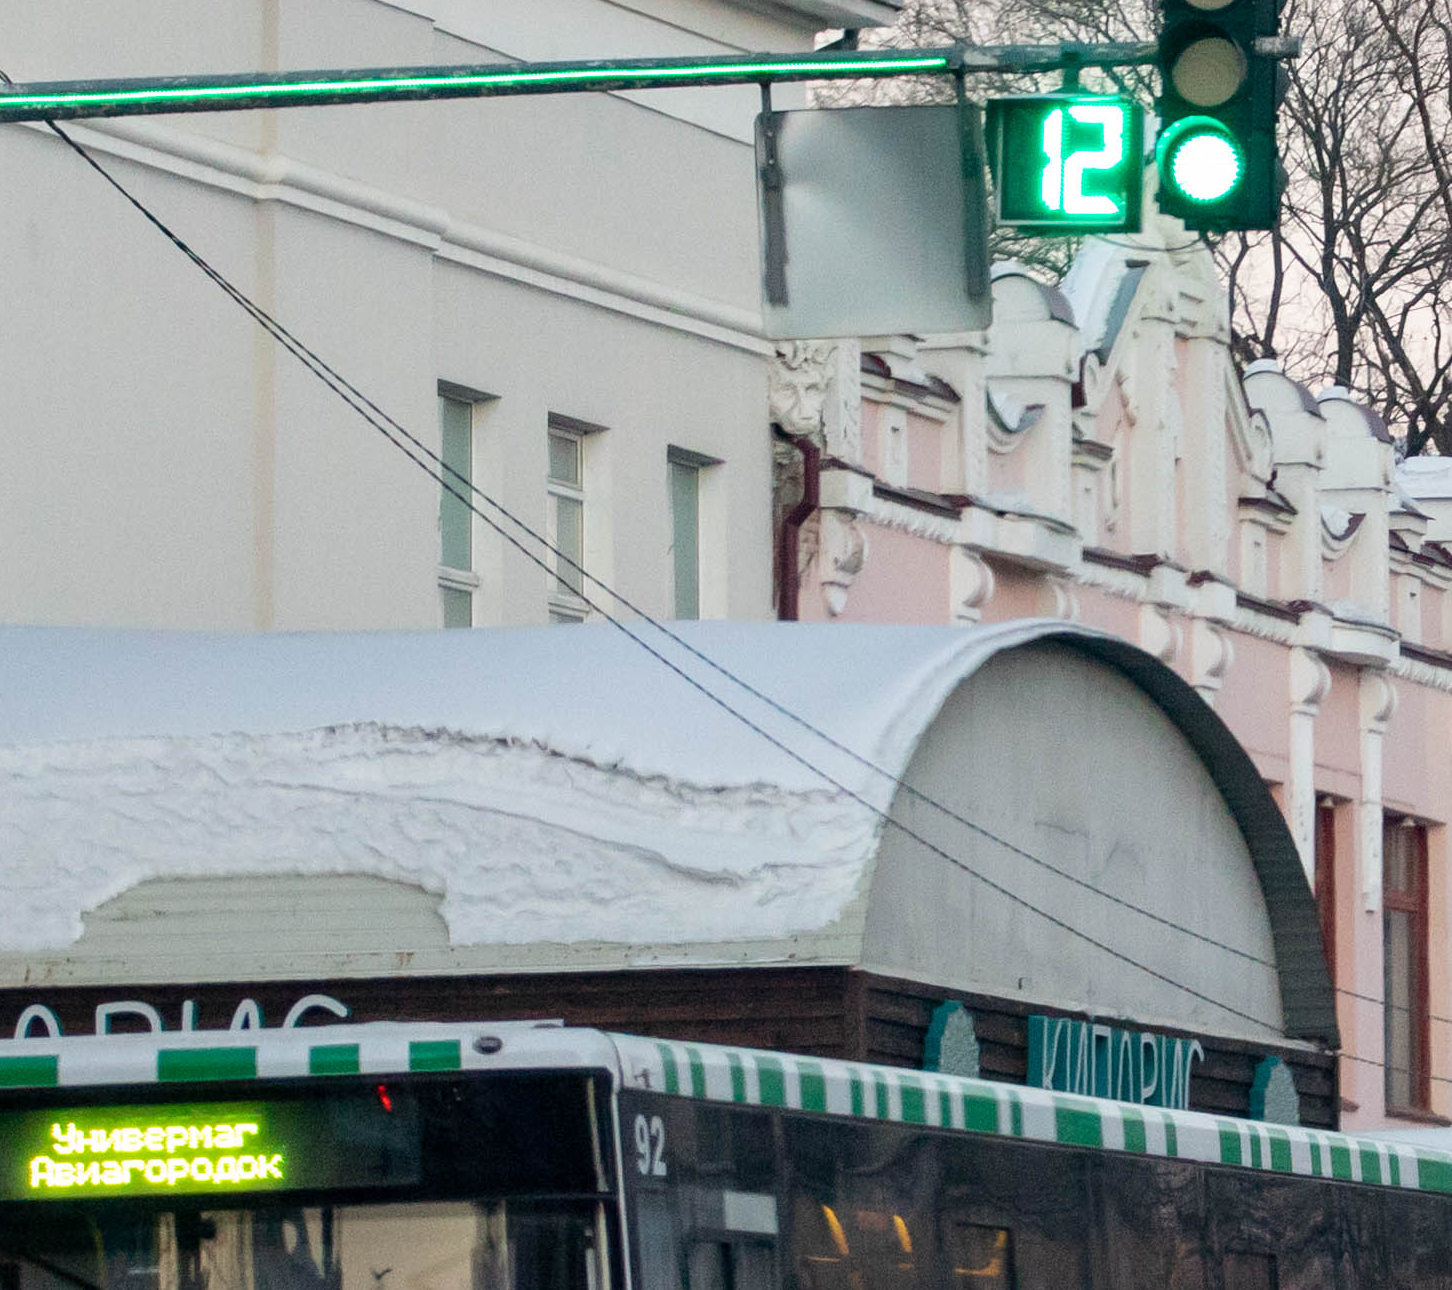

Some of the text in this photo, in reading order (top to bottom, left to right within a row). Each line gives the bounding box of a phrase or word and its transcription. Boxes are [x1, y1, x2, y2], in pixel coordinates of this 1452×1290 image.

[1040, 104, 1125, 216] 12
[51, 1120, 259, 1156] Универмаг
[634, 1114, 668, 1177] 92
[28, 1153, 284, 1189] Авиагородок
